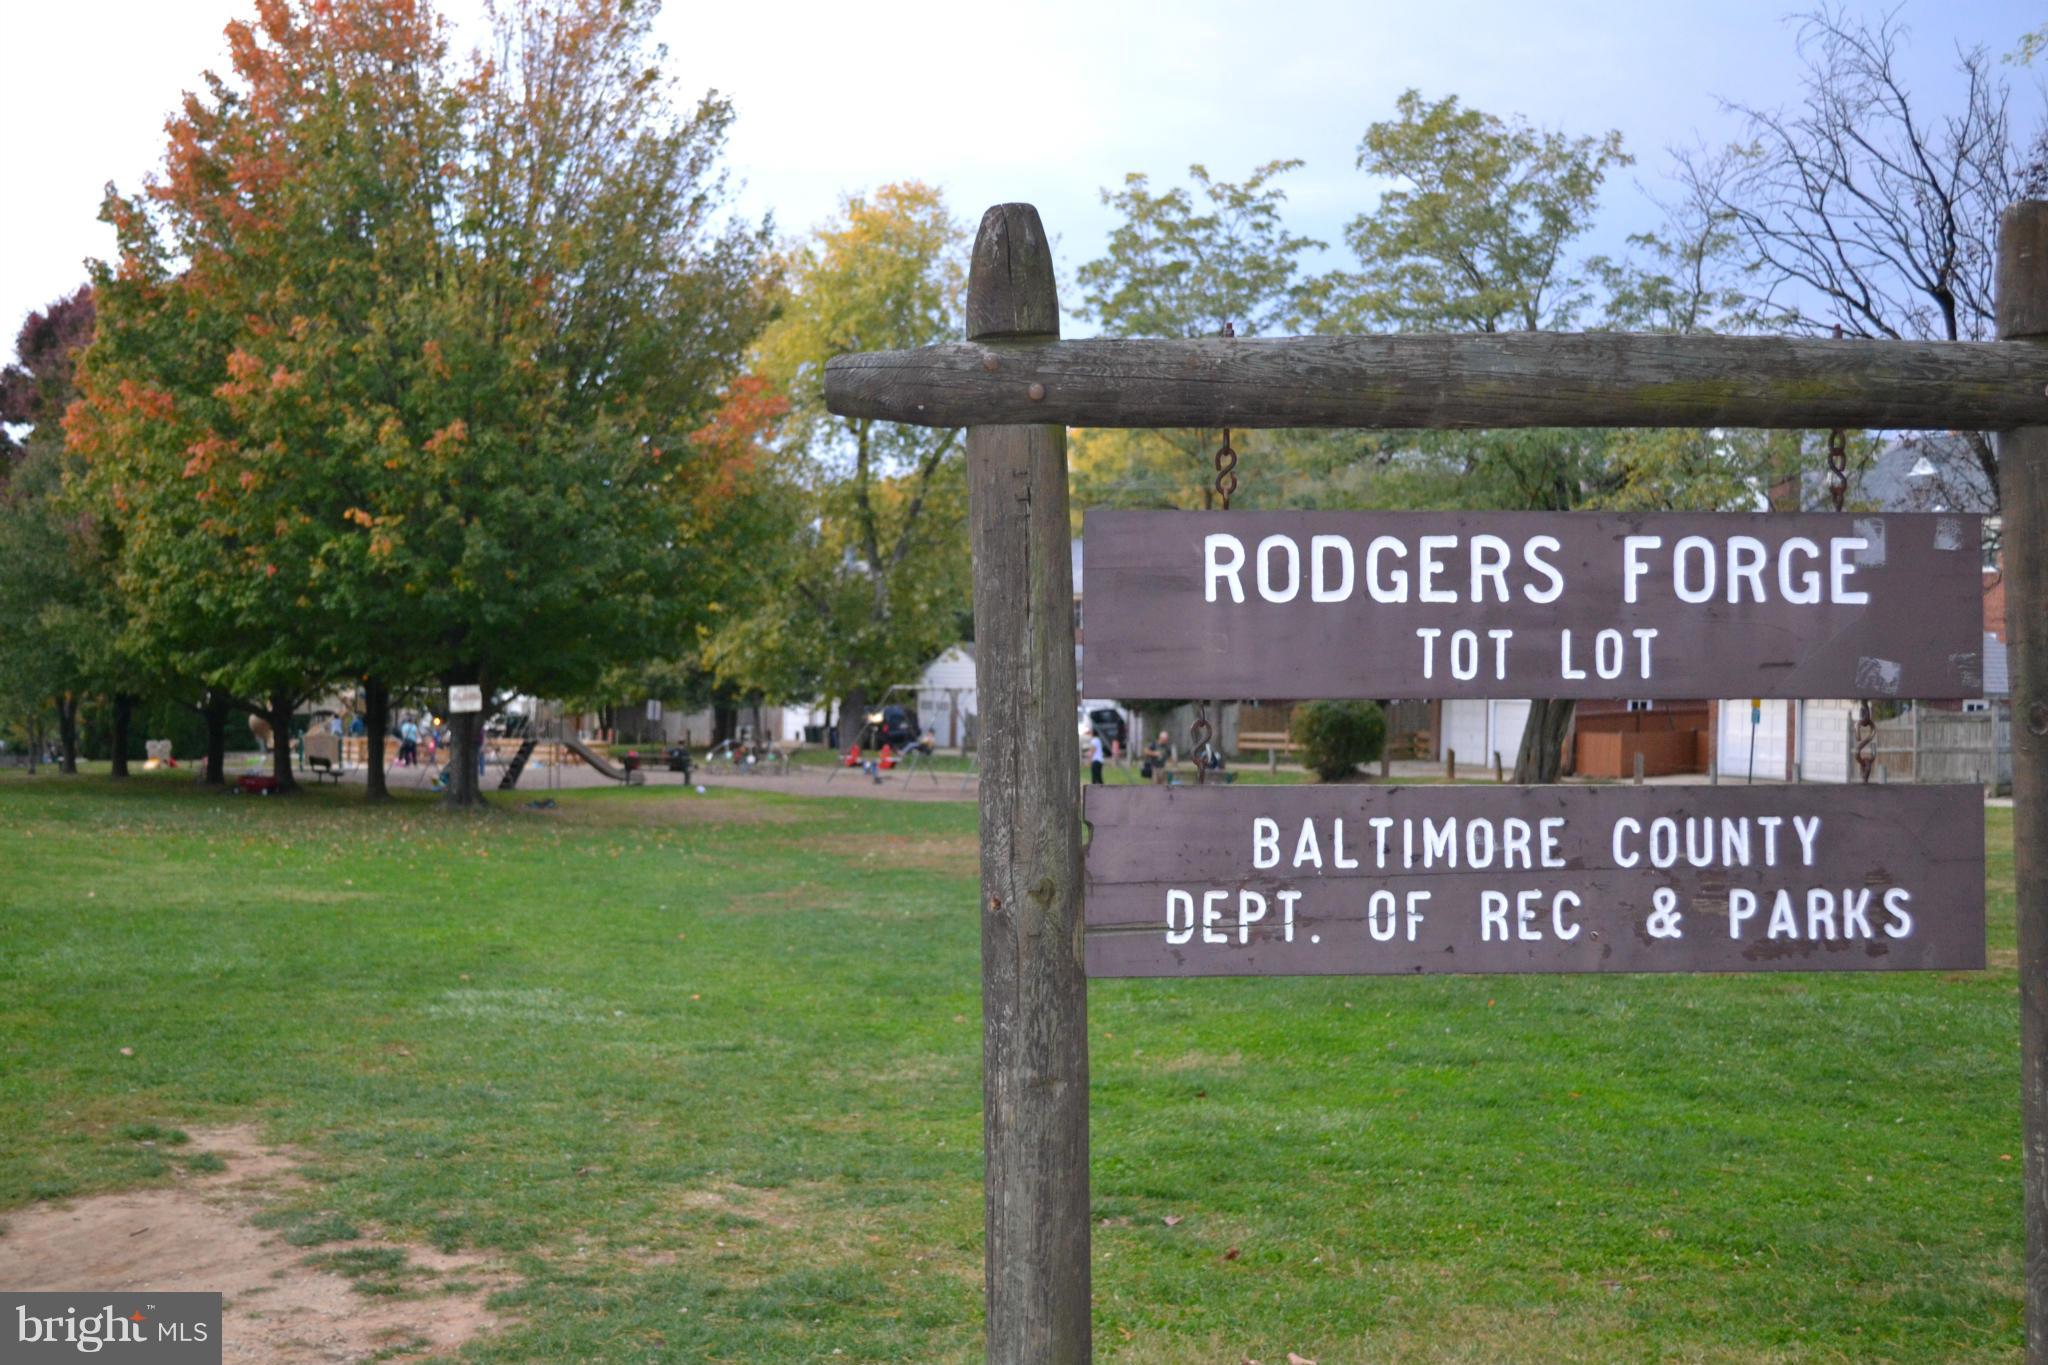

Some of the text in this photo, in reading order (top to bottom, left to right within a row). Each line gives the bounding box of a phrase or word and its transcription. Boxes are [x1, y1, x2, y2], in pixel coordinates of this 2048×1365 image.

[1203, 532, 1873, 606] RODGERS FORGE
[1415, 626, 1660, 682] TOT LOT
[1252, 814, 1821, 871] BALTIMORE COUNTY
[1164, 886, 1914, 946] DEPT. OF REC & PARKS
